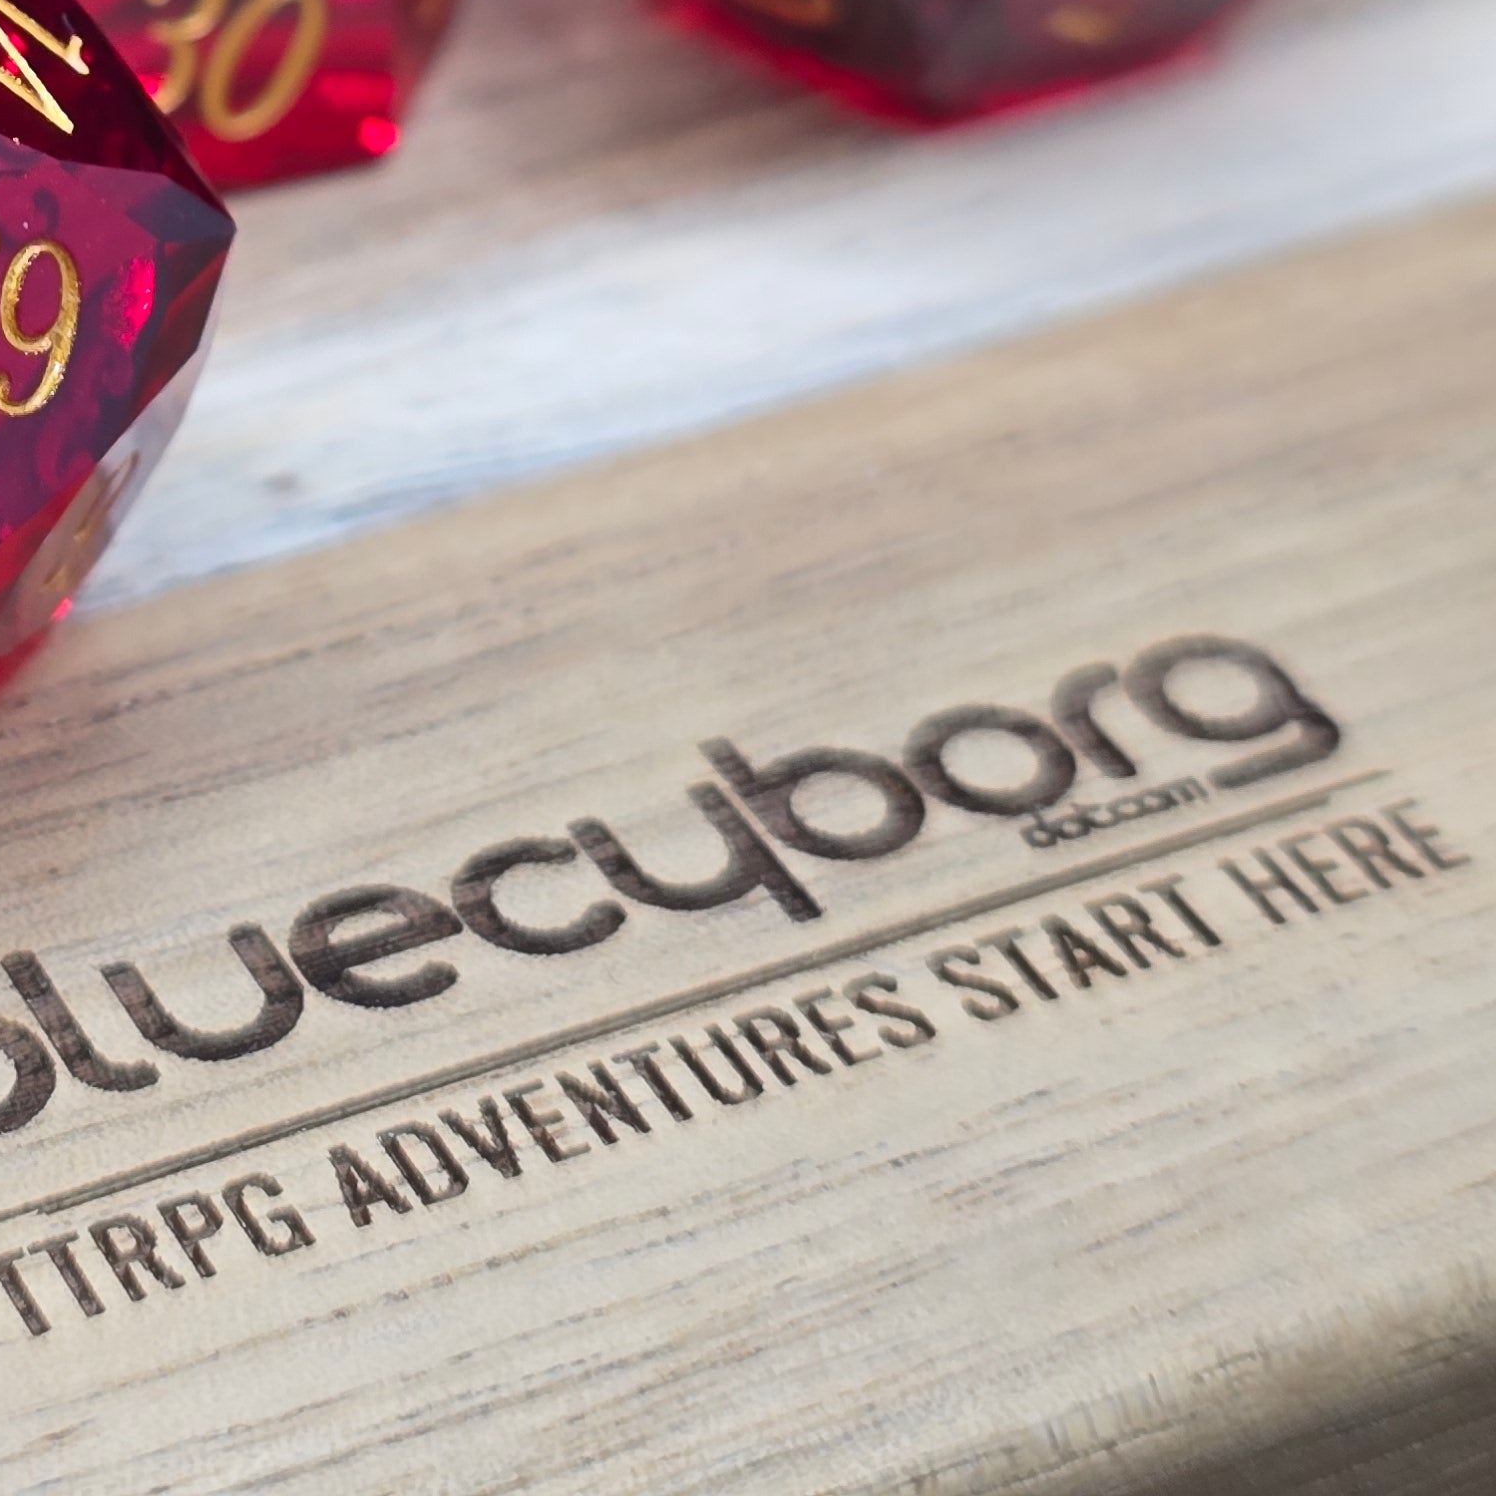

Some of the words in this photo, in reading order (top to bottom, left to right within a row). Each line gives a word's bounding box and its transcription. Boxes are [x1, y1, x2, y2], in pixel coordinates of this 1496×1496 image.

[1019, 776, 1210, 848] dotcom
[328, 972, 937, 1227] ADVENTURES
[925, 874, 1223, 1022] START
[1218, 799, 1471, 925] HERE
